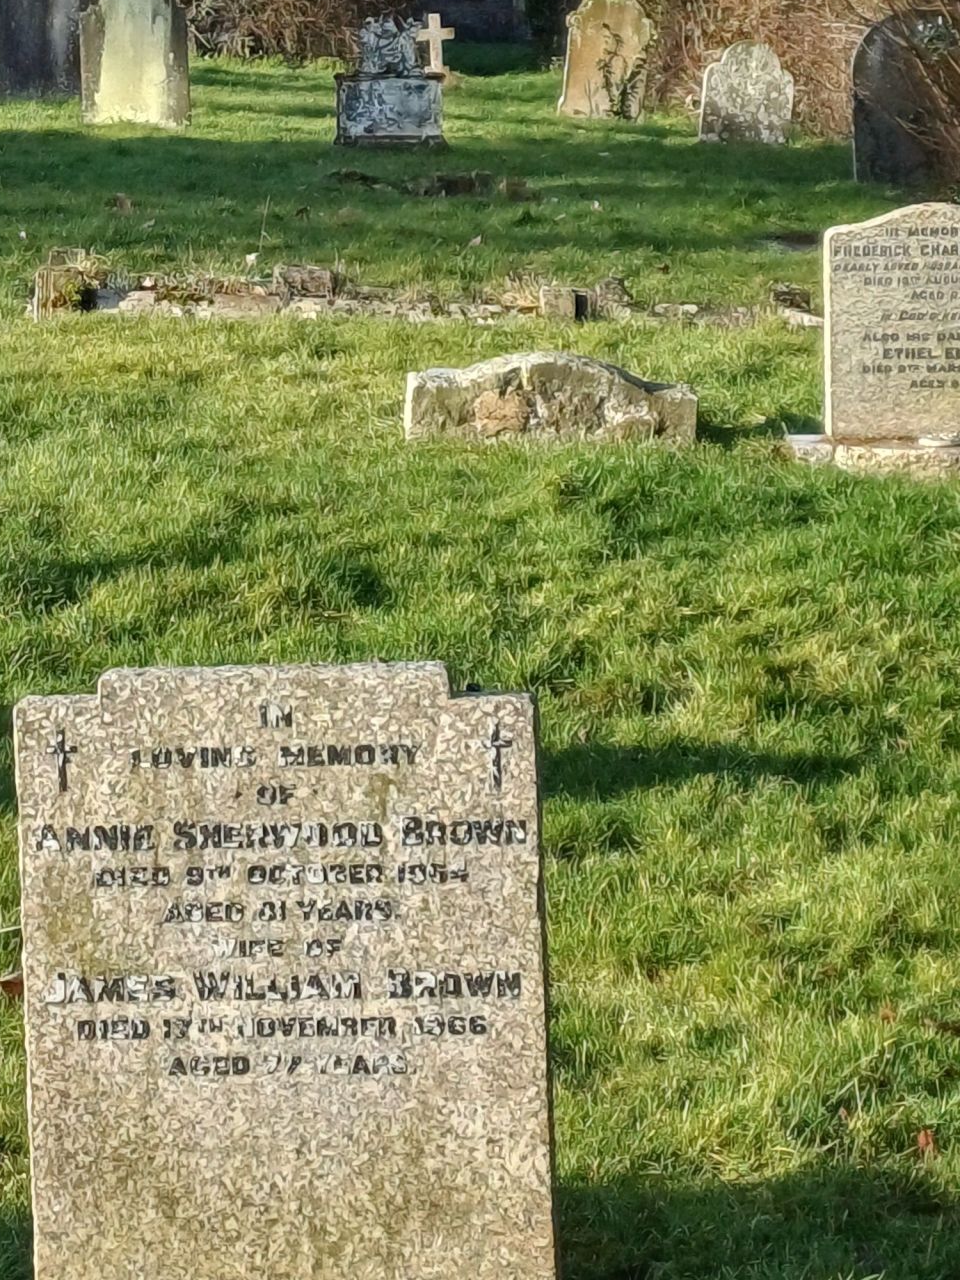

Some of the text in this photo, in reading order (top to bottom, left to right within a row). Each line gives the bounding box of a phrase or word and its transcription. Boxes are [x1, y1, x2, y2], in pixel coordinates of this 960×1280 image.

[883, 347, 940, 360] ETHEL
[258, 703, 293, 728] IN
[130, 744, 422, 768] LOVING MEMORY
[35, 816, 528, 852] ANNIE SHERWOOD BROWN
[95, 866, 171, 888] DIED
[247, 863, 384, 886] OCTOBER
[164, 900, 245, 922] AGED
[211, 937, 342, 959] WIFE OF
[42, 968, 523, 1005] JAMES WILLIAM BROWN
[76, 1018, 151, 1041] DIED
[236, 1016, 397, 1039] NOVEMBER
[168, 1055, 251, 1077] AGED
